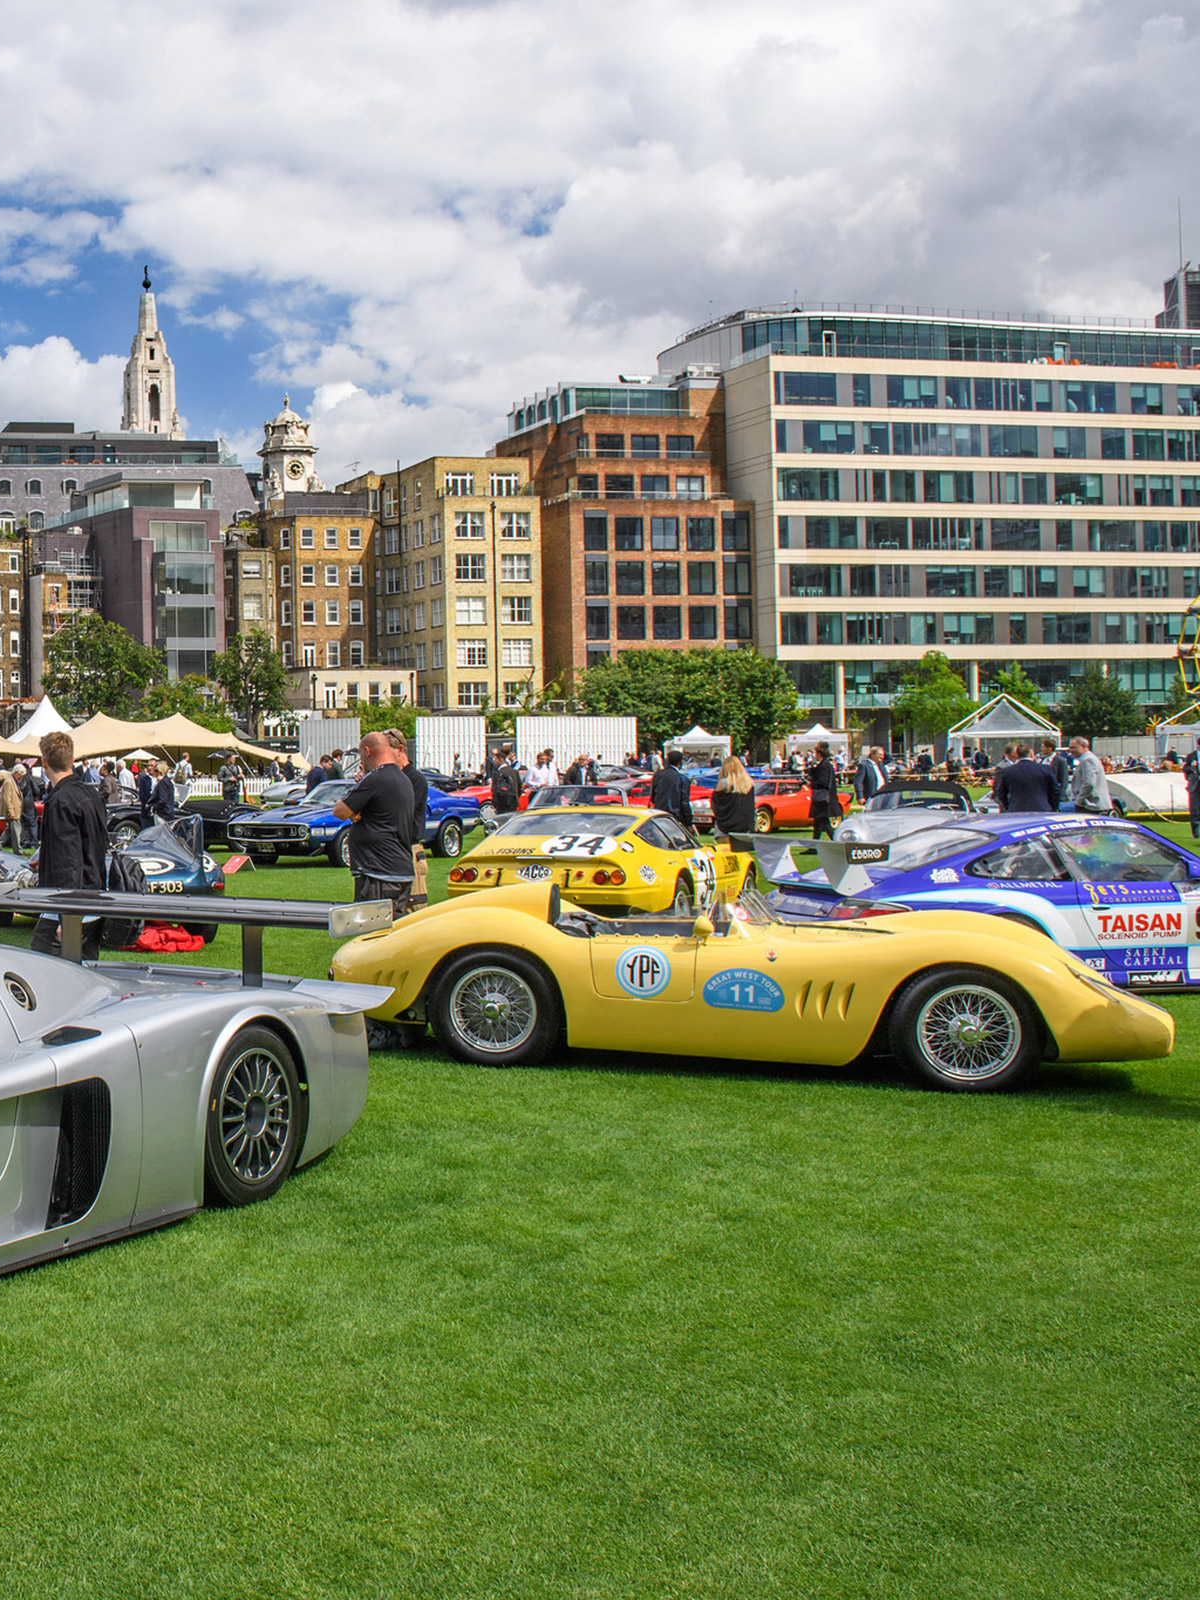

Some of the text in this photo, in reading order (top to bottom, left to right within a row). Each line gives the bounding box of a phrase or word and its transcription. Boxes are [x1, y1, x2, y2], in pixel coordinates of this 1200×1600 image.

[549, 836, 605, 855] 34
[519, 865, 550, 879] YACCO
[1097, 912, 1182, 933] TAISAN
[1097, 930, 1181, 940] SOLENOID PUMP
[1123, 956, 1183, 966] CAPITAL
[1125, 947, 1166, 957] SAEKI
[626, 954, 661, 988] YPF
[707, 971, 781, 998] GREAT WEST TOUR
[729, 983, 754, 1003] 11
